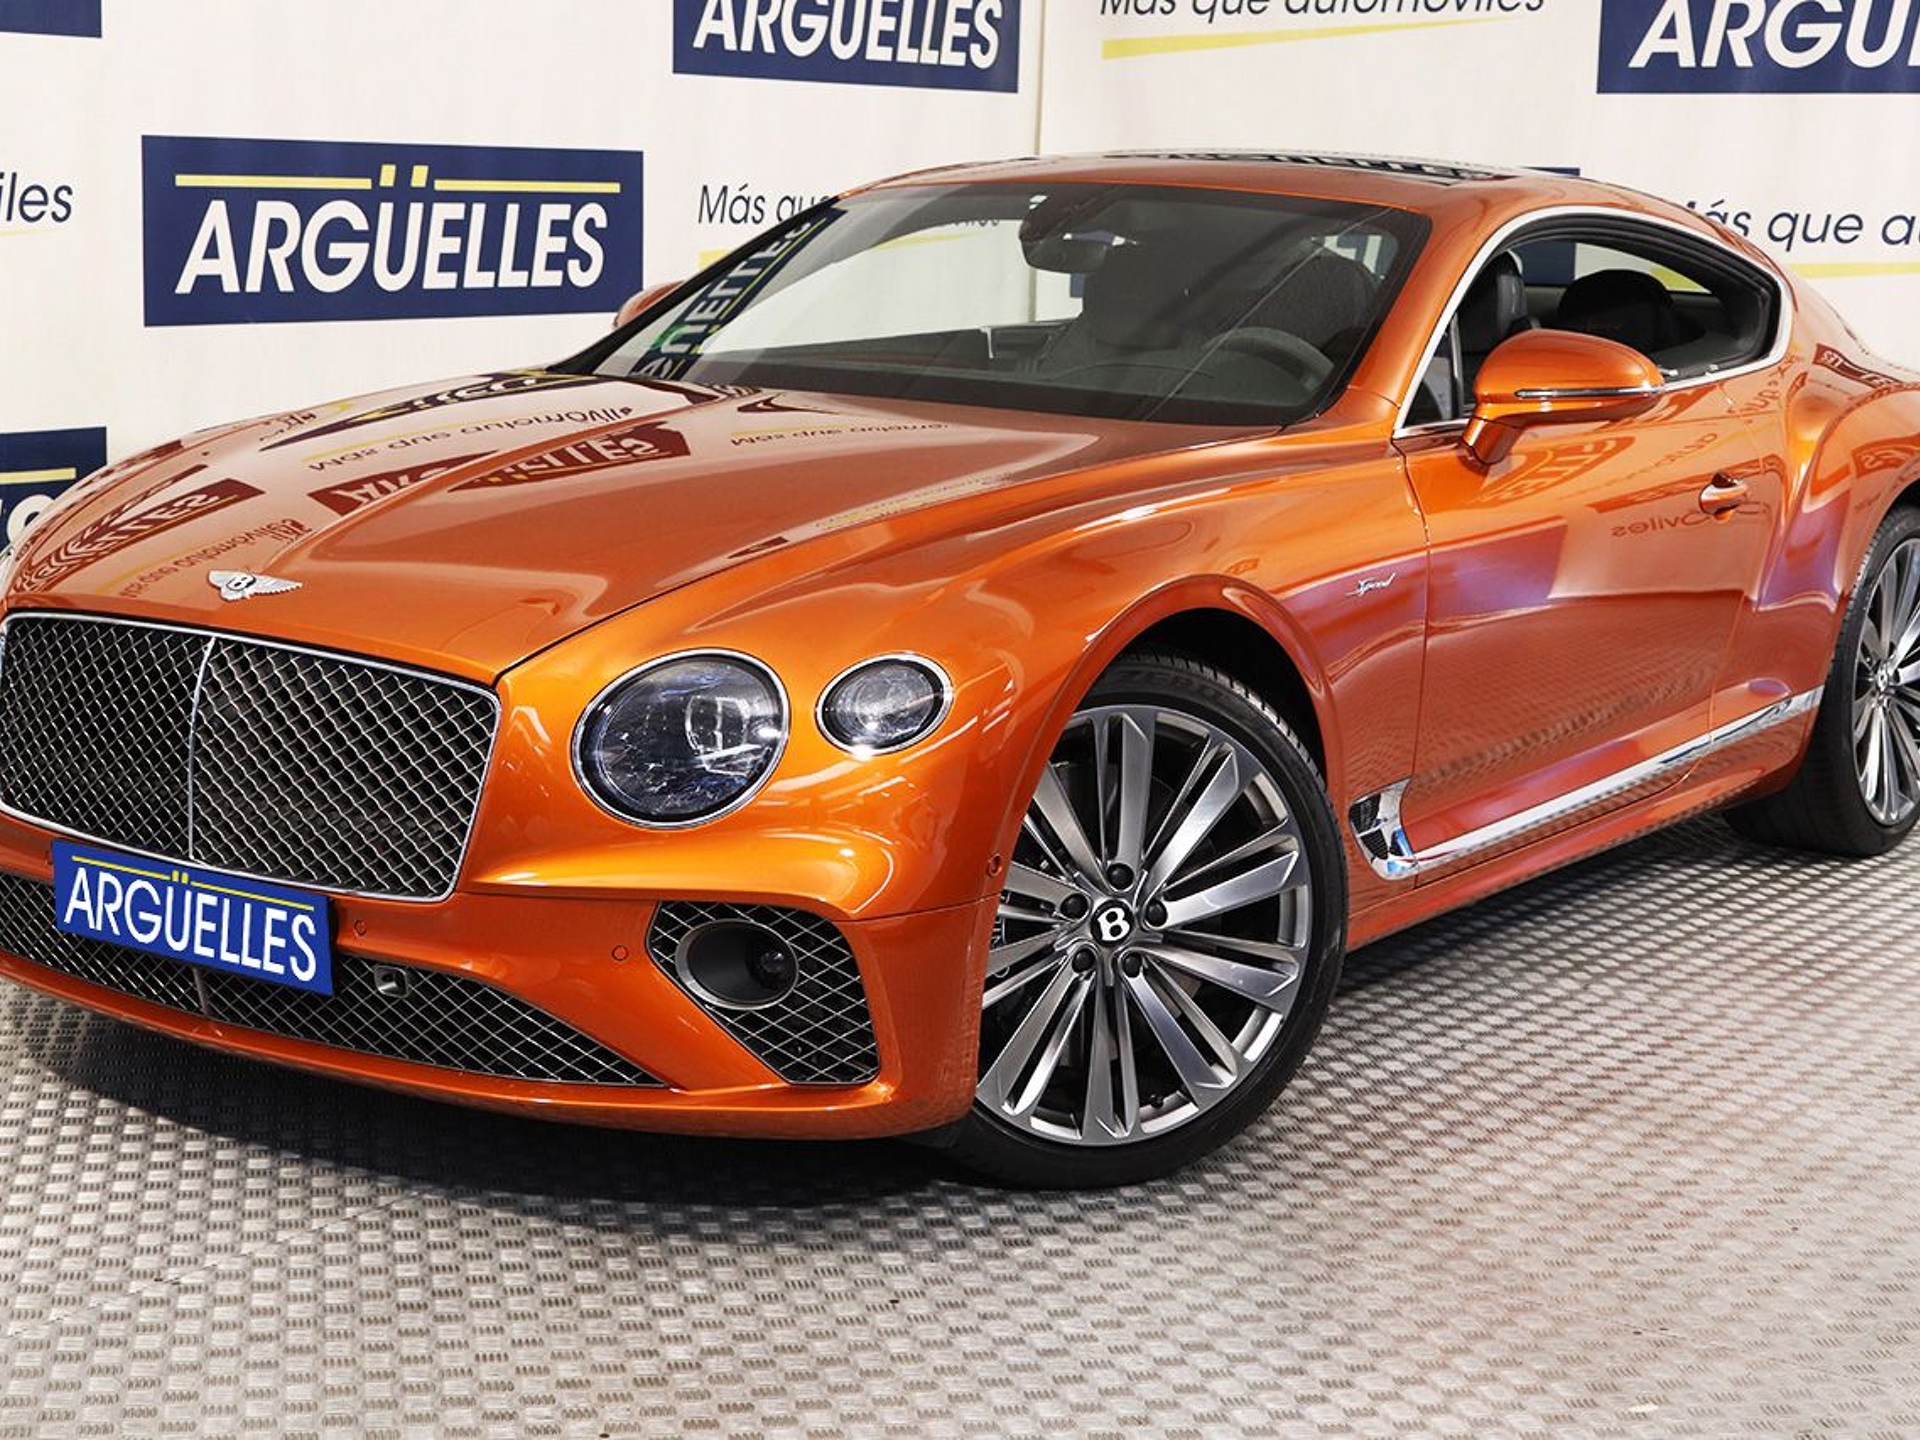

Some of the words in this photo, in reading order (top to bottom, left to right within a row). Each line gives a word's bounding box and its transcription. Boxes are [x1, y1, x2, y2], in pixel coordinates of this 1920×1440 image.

[698, 183, 766, 225] Más
[174, 164, 609, 294] ARGÜELLES
[1767, 211, 1864, 252] que
[64, 867, 317, 982] ARGÜELLES
[1097, 907, 1131, 941] B
